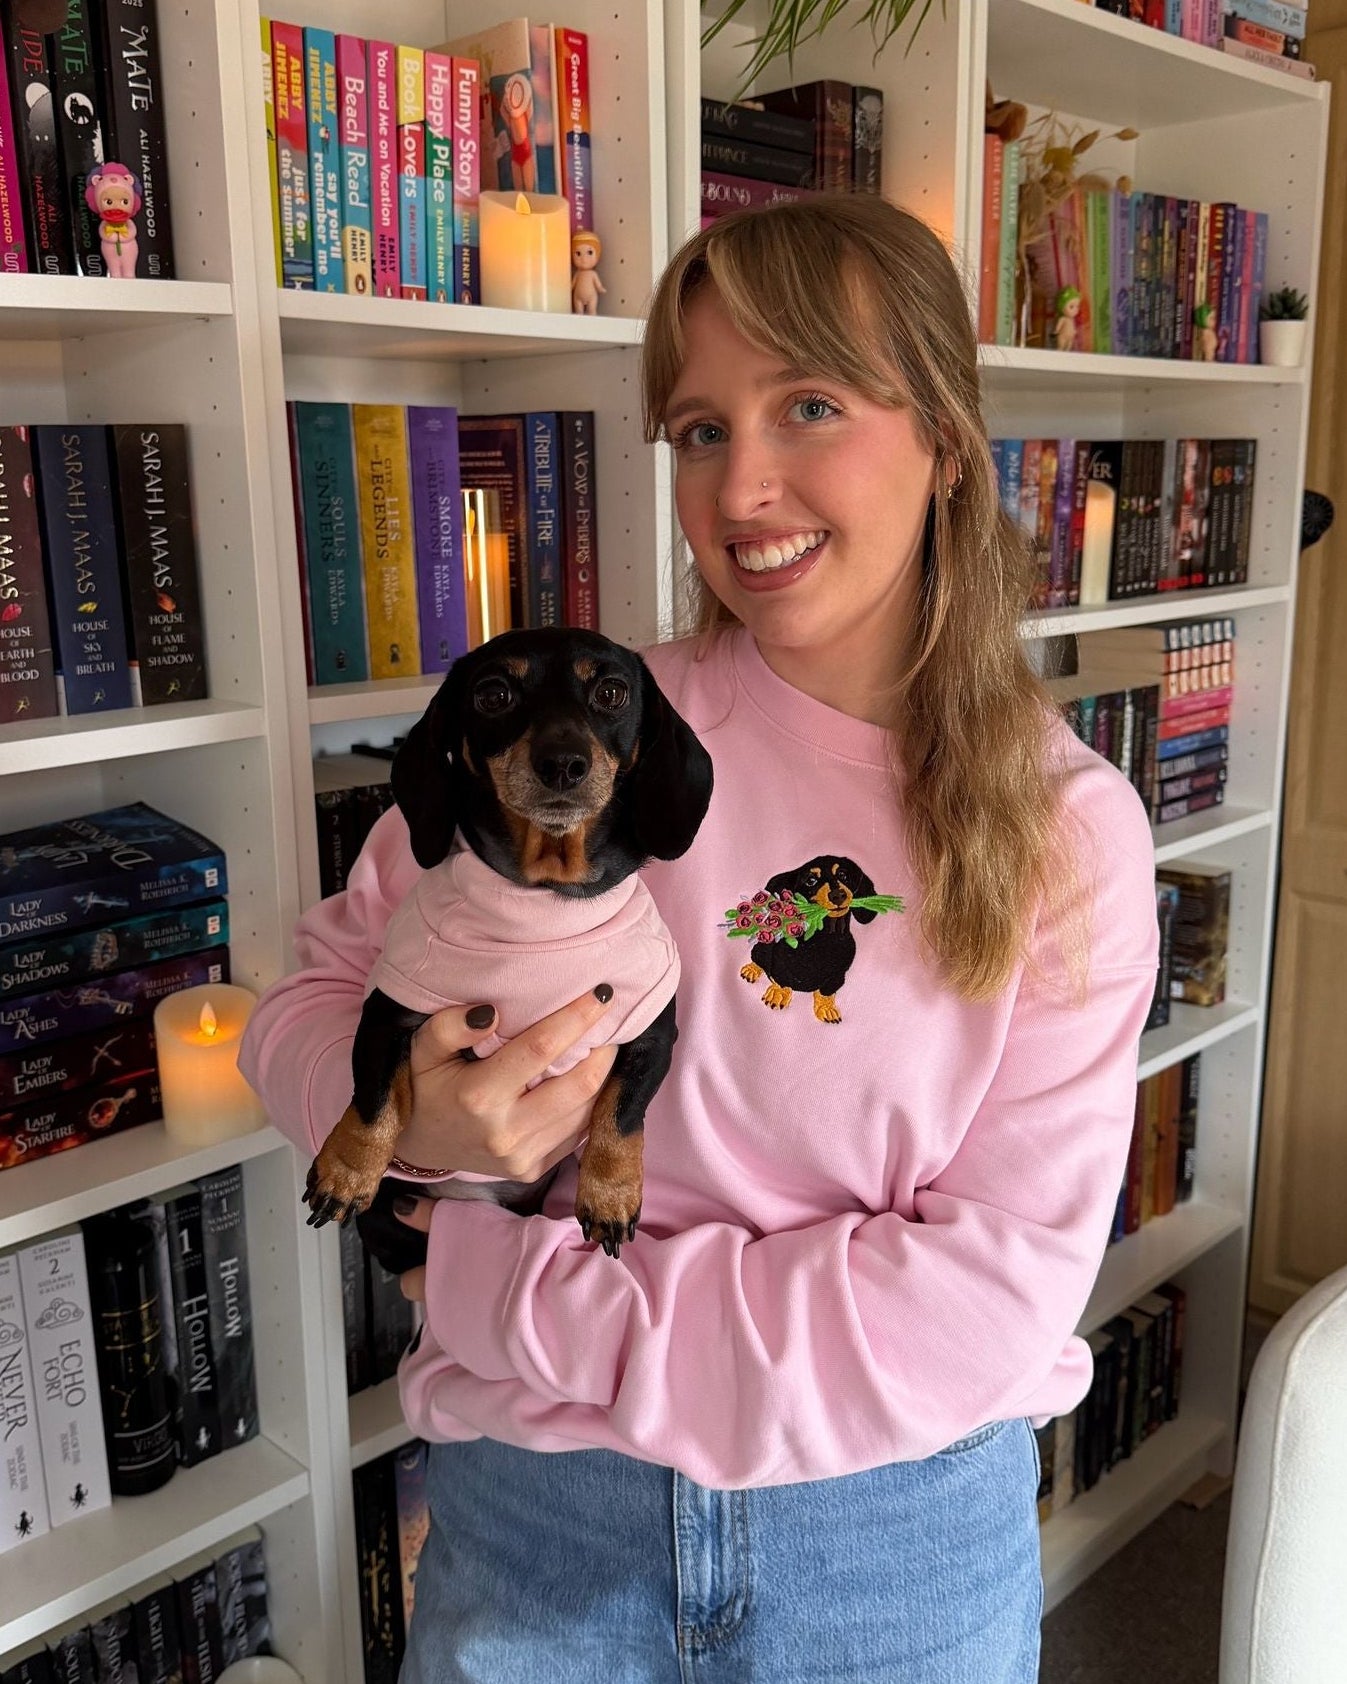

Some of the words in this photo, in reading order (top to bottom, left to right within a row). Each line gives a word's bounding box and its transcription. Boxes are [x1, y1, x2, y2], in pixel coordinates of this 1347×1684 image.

[20, 29, 43, 74] IDE
[120, 25, 154, 111] MATE
[376, 50, 389, 77] You
[275, 41, 290, 120] JIMENEZ
[290, 55, 303, 111] ABBY
[309, 47, 322, 124] JIMENEZ
[323, 61, 337, 116] ABBY
[404, 58, 421, 117] Book
[570, 52, 581, 94] Great
[345, 76, 366, 143] Beach
[378, 83, 389, 112] and
[425, 64, 449, 139] Happy
[454, 67, 477, 135] Funny
[140, 129, 150, 150] ALI
[378, 114, 389, 131] Me
[281, 149, 292, 180] the
[379, 140, 389, 160] on
[403, 124, 418, 198] Lovers
[454, 138, 477, 197] Story
[292, 166, 307, 206] just
[326, 172, 338, 203] say
[347, 151, 368, 208] Read
[432, 143, 450, 203] Place
[34, 175, 50, 249] HAZELWOOD
[141, 155, 157, 238] HAZELWOOD
[313, 152, 327, 245] remember
[379, 162, 392, 227] Vacation
[283, 185, 295, 258] summer
[295, 211, 308, 242] for
[326, 208, 342, 260] you'll
[436, 208, 444, 243] EMILY
[317, 249, 328, 276] me
[350, 230, 358, 263] HENRY
[380, 233, 388, 274] HENRY
[388, 237, 396, 273] EMILY
[436, 246, 446, 285] HENRY
[462, 248, 471, 287] HENRY
[61, 433, 87, 508] SARAH
[140, 431, 166, 506] SARAH
[573, 450, 589, 495] VOW
[314, 460, 335, 563] SINNERS
[331, 496, 347, 559] SOULS
[370, 459, 390, 560] LEGENDS
[386, 497, 401, 542] LIES
[438, 496, 453, 558] SMOKE
[536, 508, 555, 548] FIRE
[72, 531, 96, 594] MAAS
[150, 525, 173, 589] MAAS
[441, 564, 450, 601] KAYLA
[72, 620, 110, 633] HOUSE
[149, 612, 186, 625] HOUSE
[0, 648, 35, 662] EARTH
[83, 641, 103, 653] SKY
[152, 633, 187, 646] FLAME
[0, 669, 40, 683] BLOOD
[75, 661, 116, 676] BREATH
[148, 653, 195, 668] SHADOW
[0, 911, 68, 938] DARKNESS
[10, 899, 42, 917] LADY
[1, 962, 70, 990] SHADOWS
[14, 950, 46, 968] LADY
[0, 1007, 31, 1026] LADY
[14, 1017, 59, 1041] ASHES
[13, 1068, 68, 1095] EMBERS
[21, 1056, 53, 1075] LADY
[14, 1123, 76, 1154] STARFIRE
[24, 1112, 57, 1132] LADY
[179, 1228, 193, 1253] 1
[48, 1258, 60, 1275] 2
[218, 1256, 243, 1340] HOLLOW
[181, 1291, 213, 1393] HOLLOW
[43, 1357, 63, 1401] FORT
[59, 1339, 87, 1408] ECHO
[0, 1346, 29, 1443] NEVER
[148, 1603, 164, 1651] LIGHT
